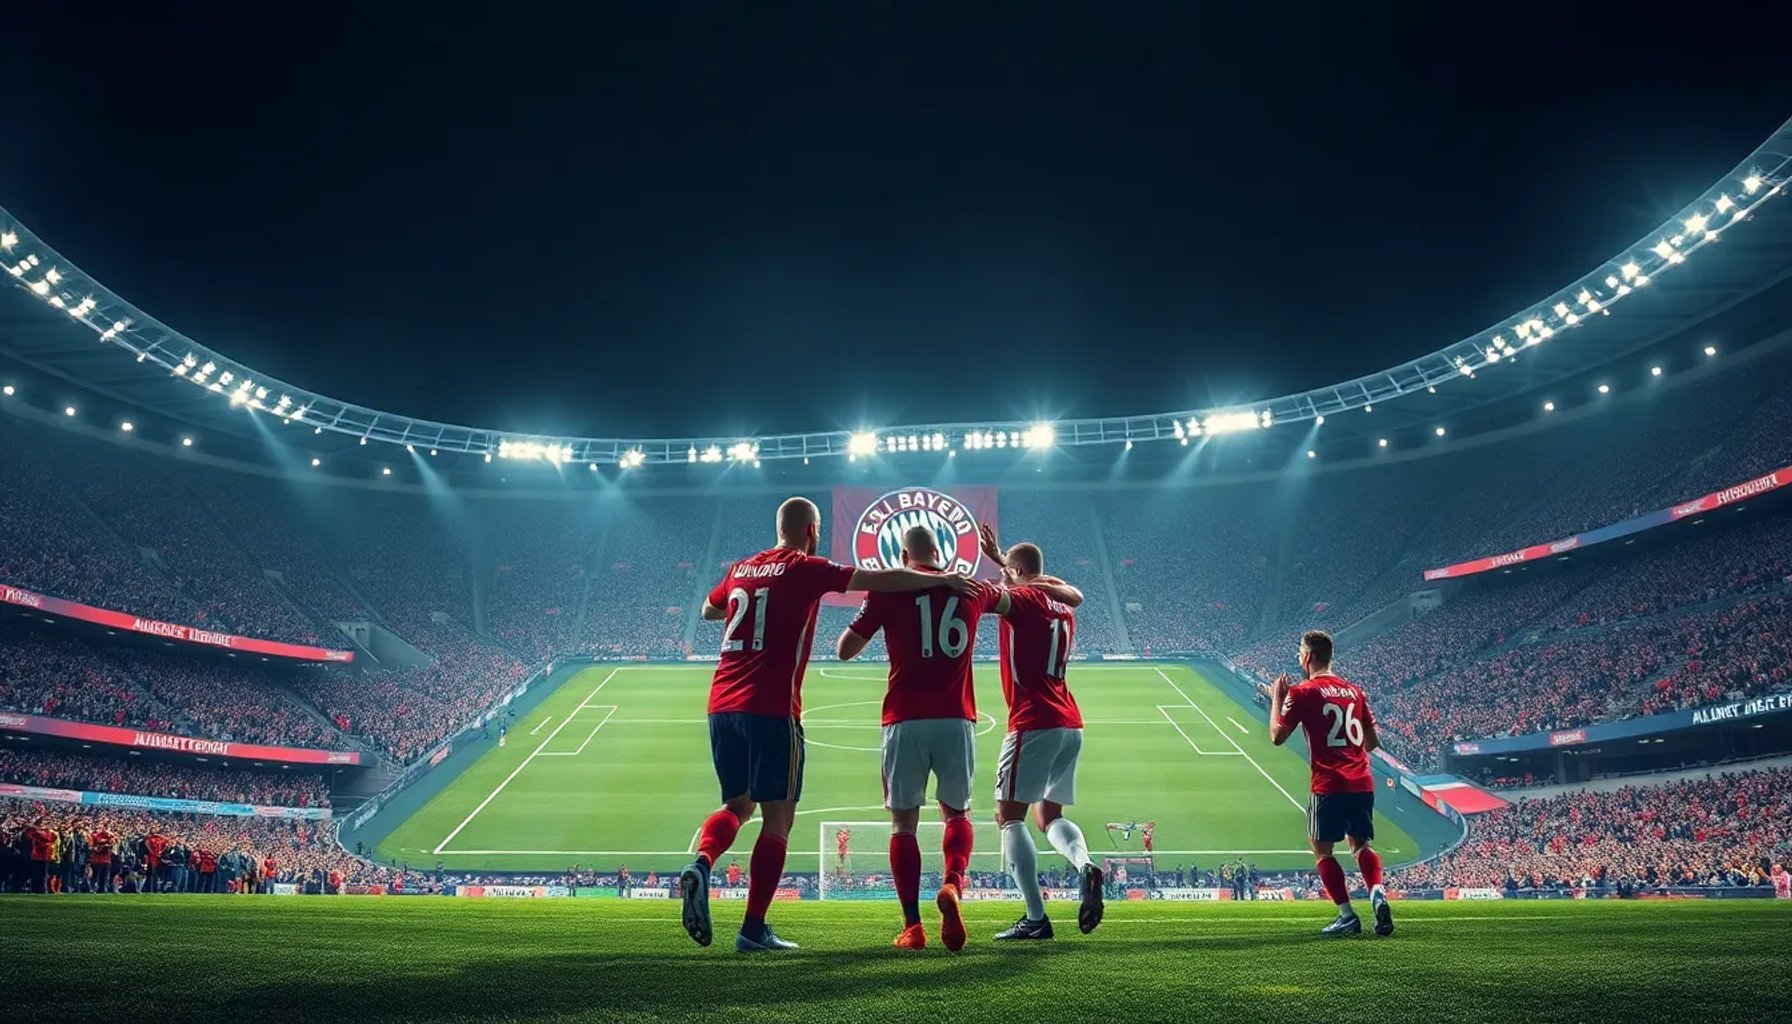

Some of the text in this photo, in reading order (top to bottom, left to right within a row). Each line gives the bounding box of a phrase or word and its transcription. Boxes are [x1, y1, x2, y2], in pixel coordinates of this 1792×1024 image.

[721, 587, 769, 652] 21
[915, 593, 969, 659] 16
[1322, 702, 1364, 747] 26
